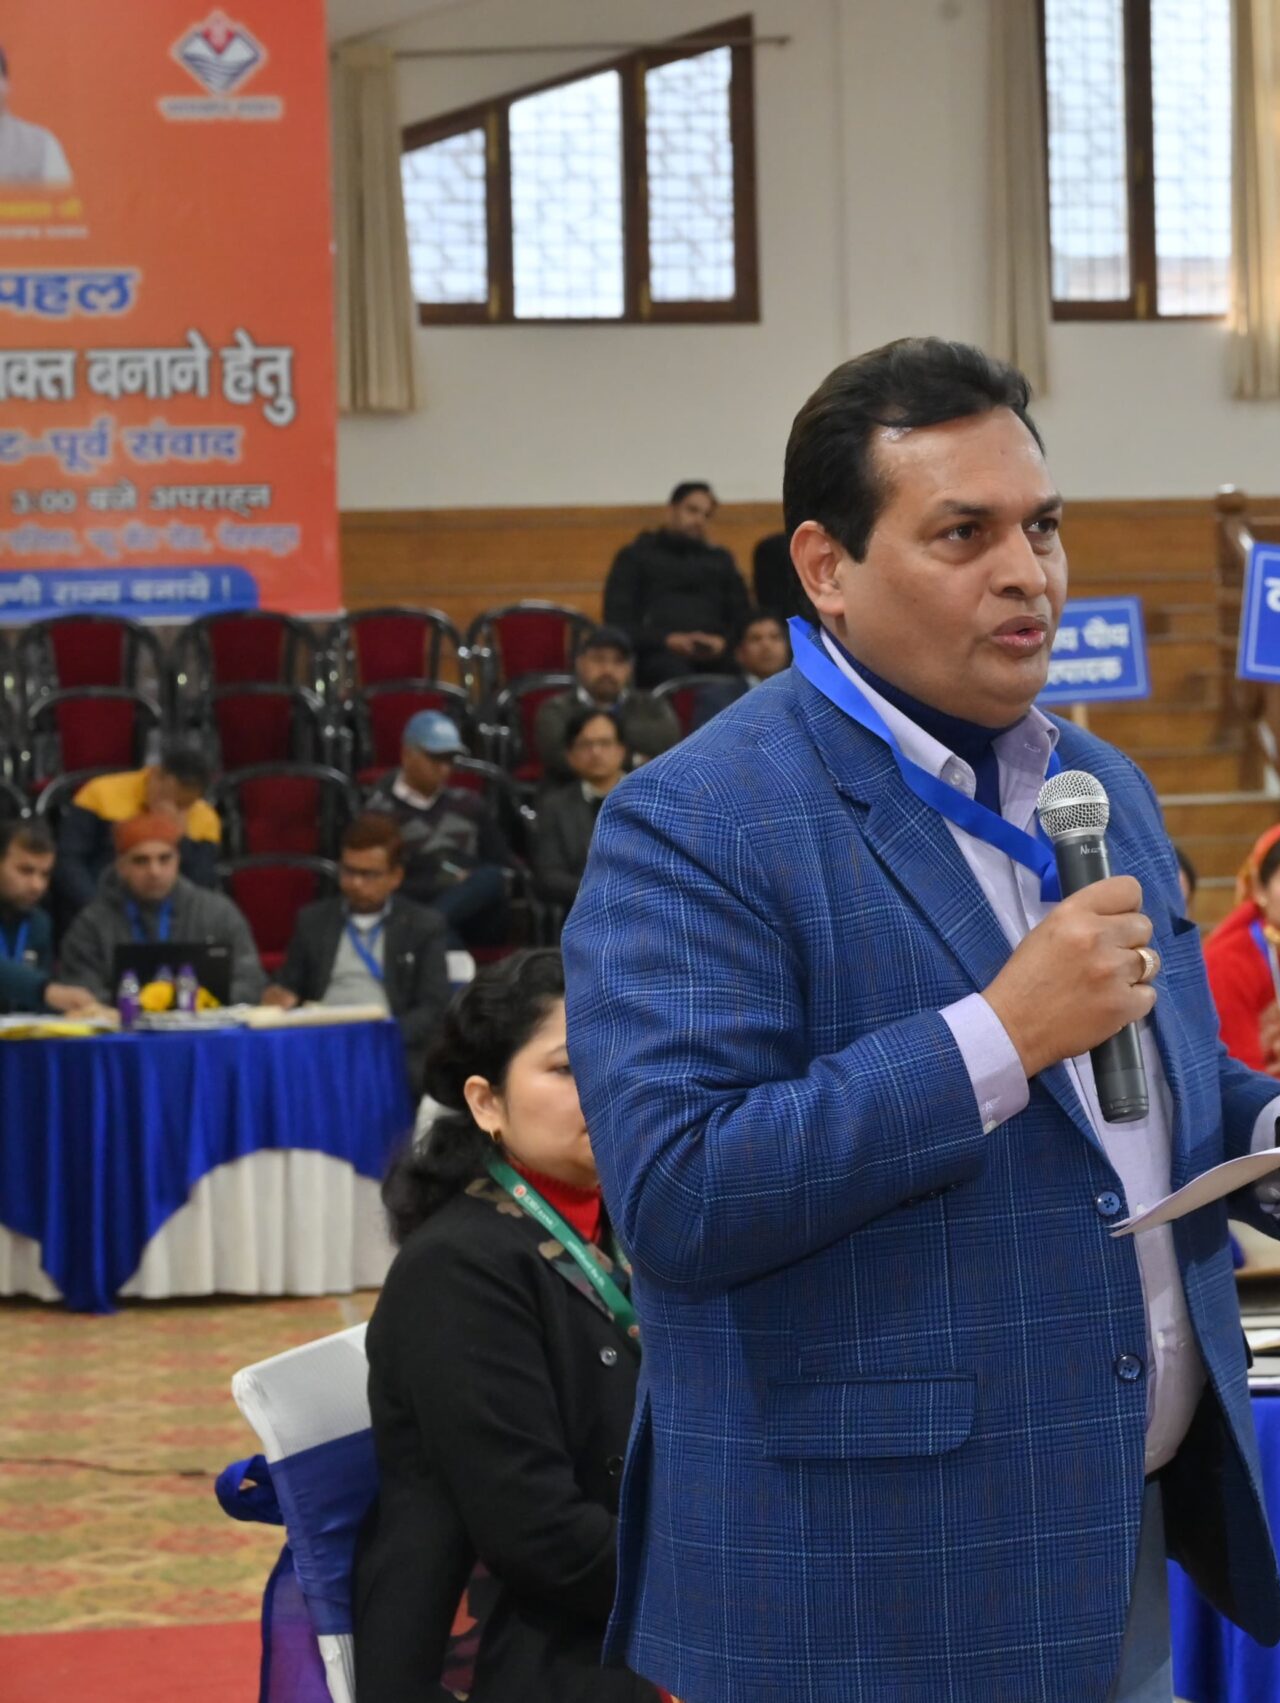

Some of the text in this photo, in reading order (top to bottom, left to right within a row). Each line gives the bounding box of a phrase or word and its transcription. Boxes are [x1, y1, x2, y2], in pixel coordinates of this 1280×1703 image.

[0, 327, 297, 427] क्त बनाने हेतु
[127, 418, 241, 461] संवाद
